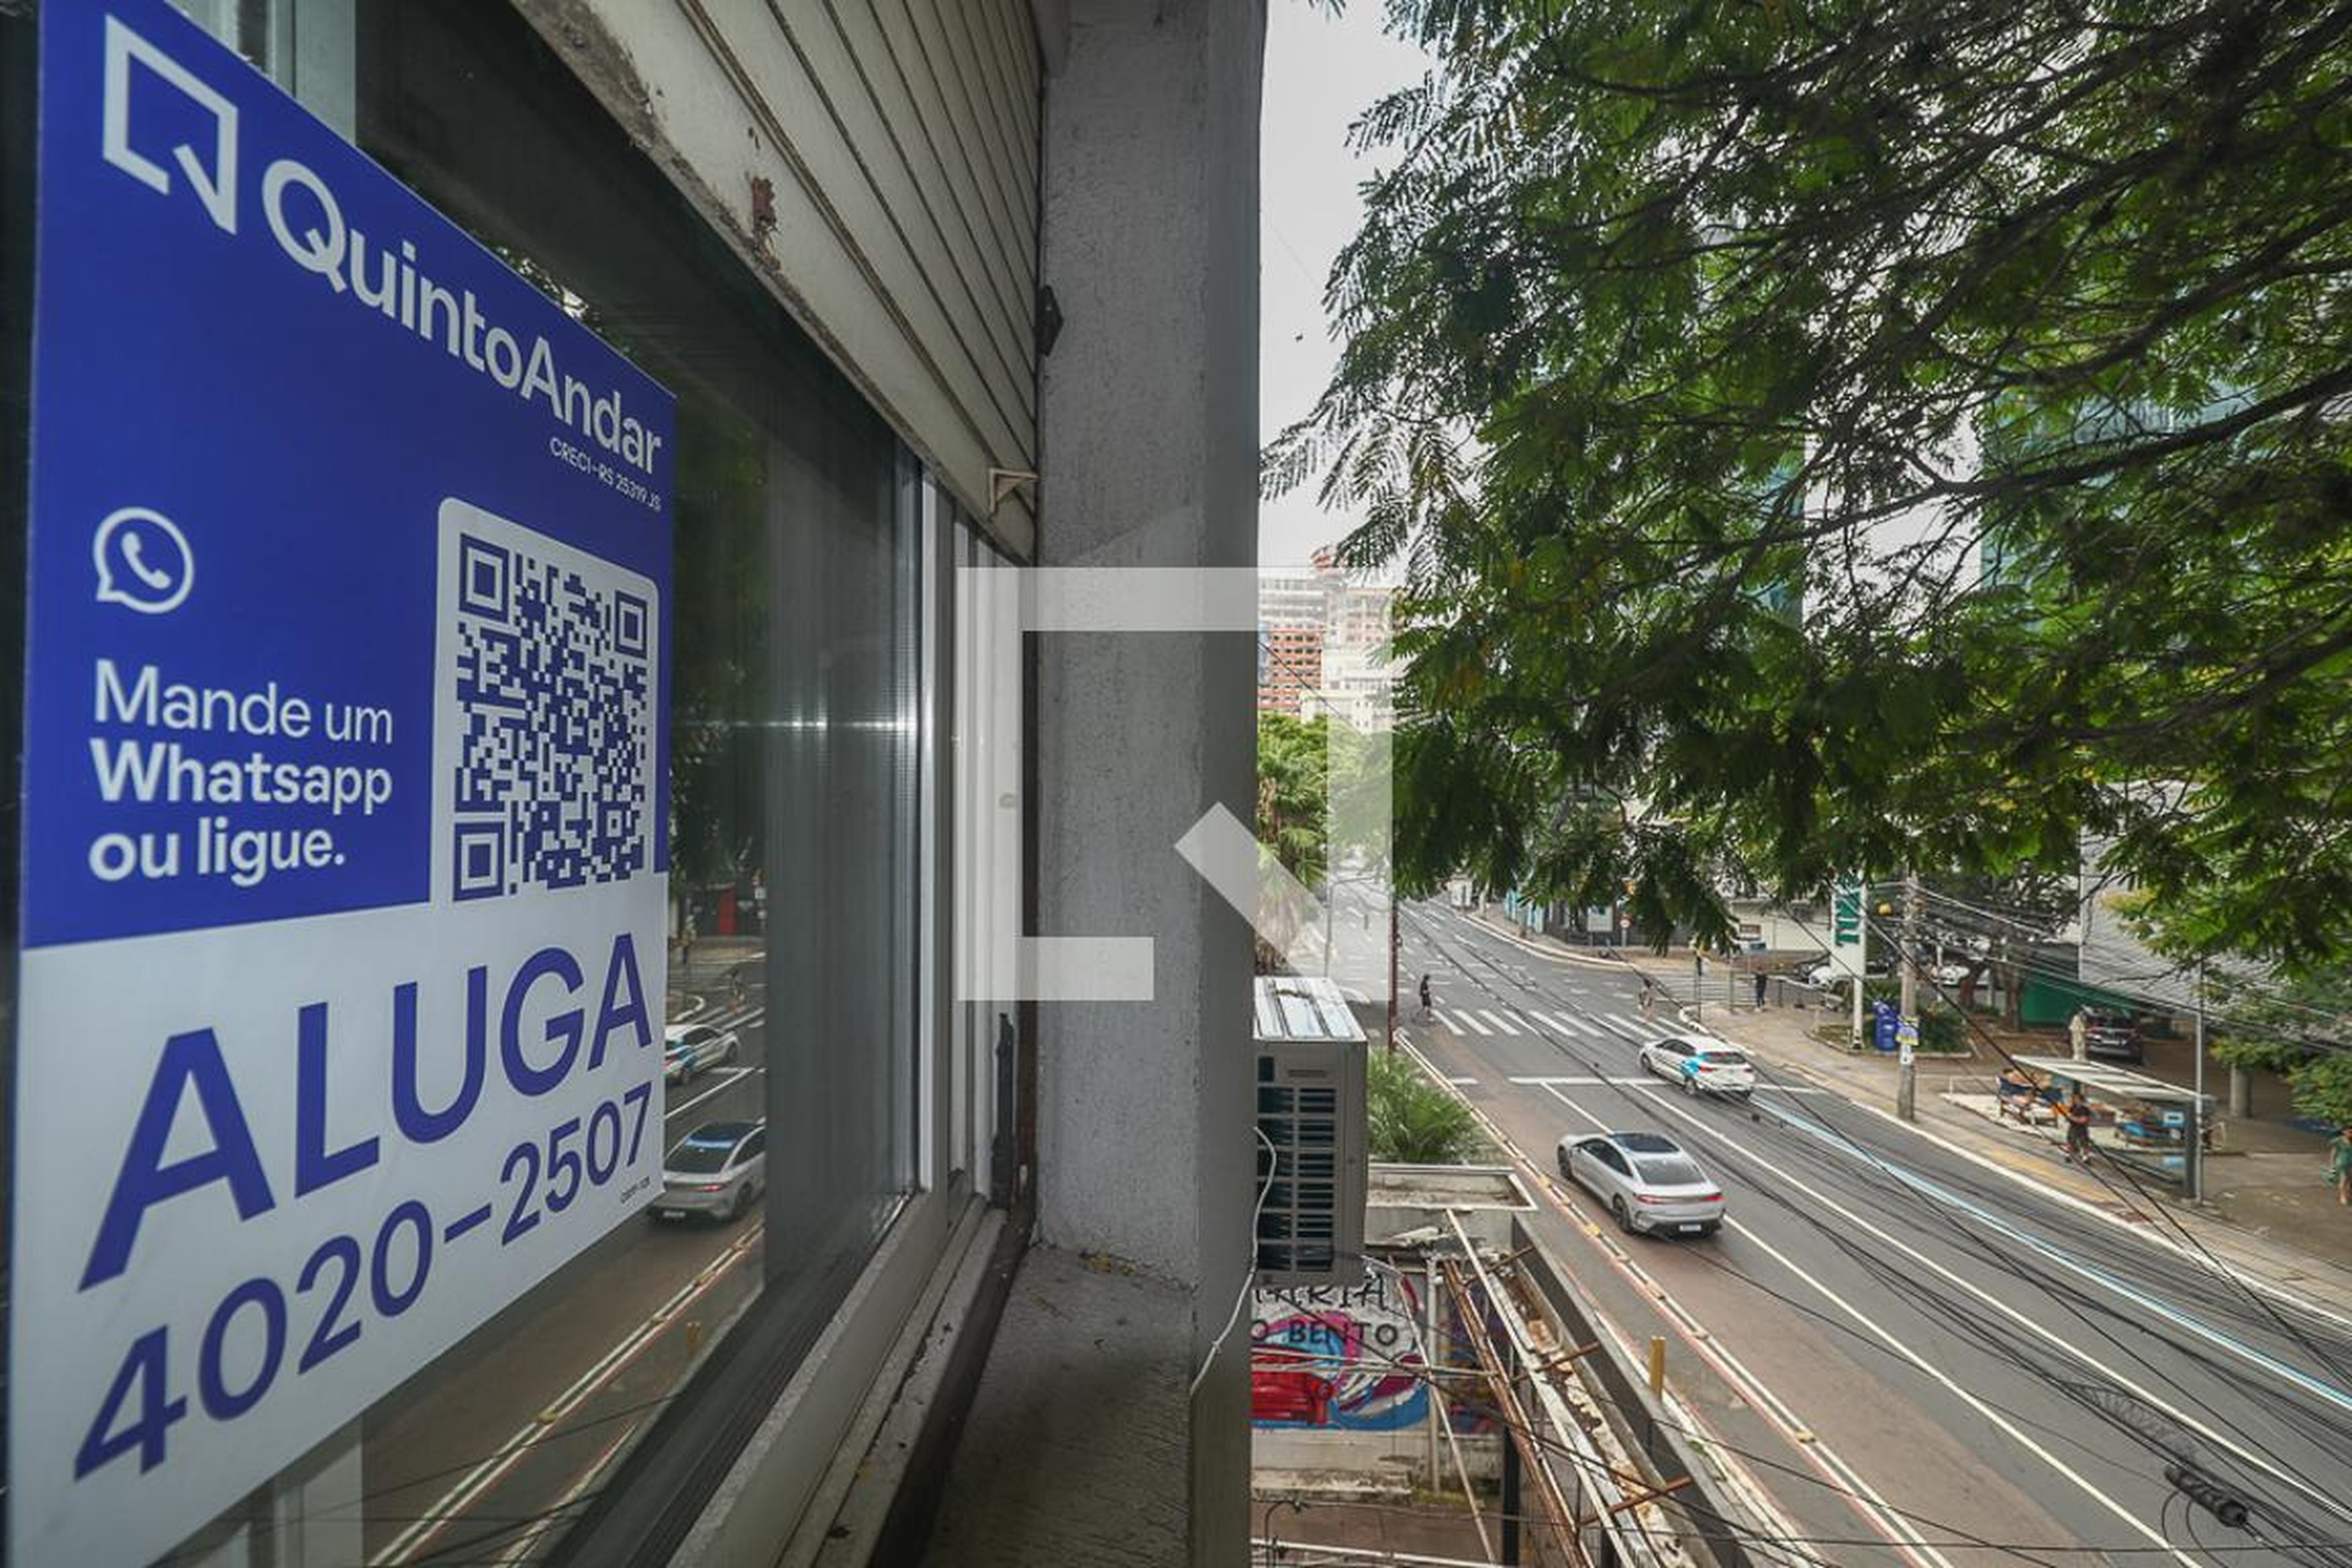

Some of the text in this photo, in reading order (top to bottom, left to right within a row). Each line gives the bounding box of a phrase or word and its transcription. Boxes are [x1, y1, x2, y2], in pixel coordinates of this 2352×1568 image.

[262, 159, 662, 475] QuintoAndar
[550, 436, 614, 486] CRECI-RS
[95, 658, 393, 744] Mande um
[90, 738, 392, 815] Whatsapp
[89, 816, 345, 887] ou ligue.
[78, 932, 652, 1292] ALUGA
[73, 1081, 652, 1483] 4020-2507
[1289, 1318, 1398, 1346] BENTO
